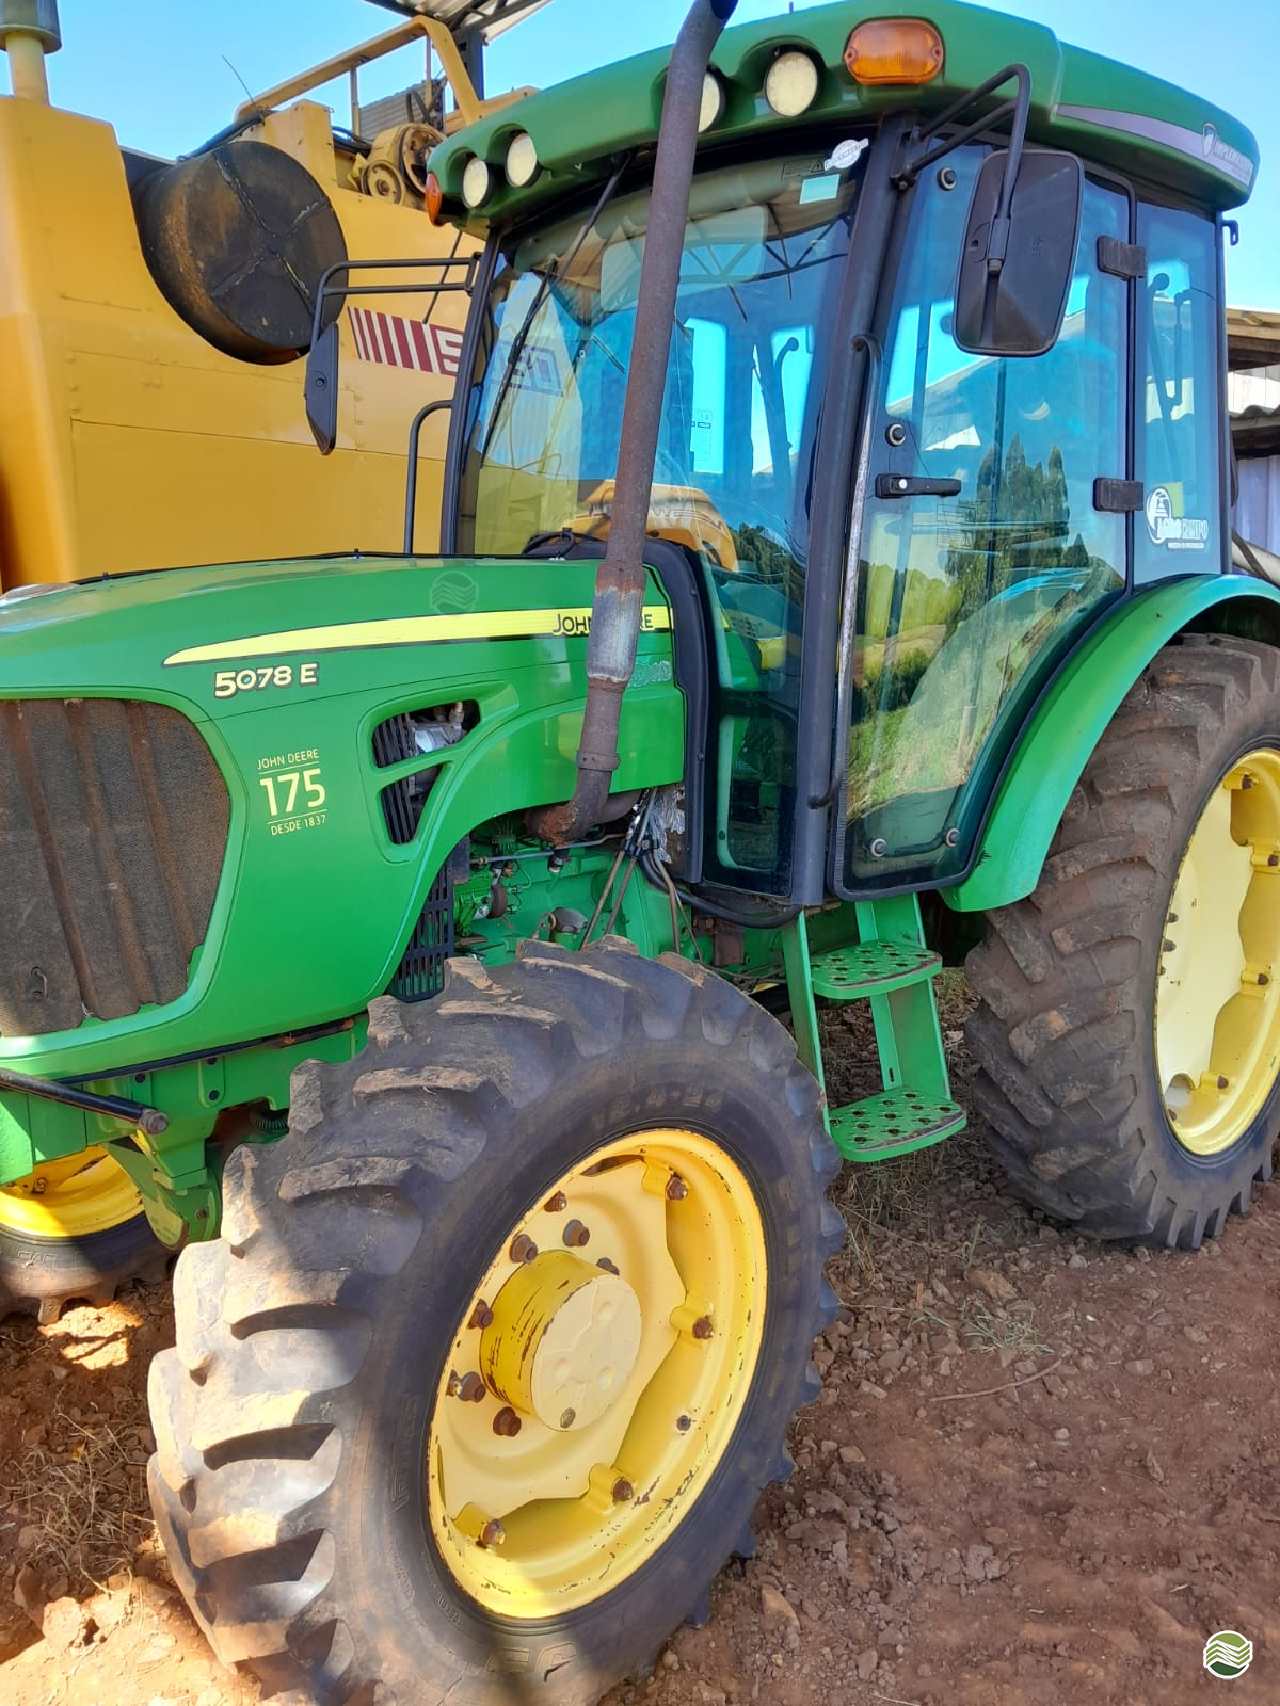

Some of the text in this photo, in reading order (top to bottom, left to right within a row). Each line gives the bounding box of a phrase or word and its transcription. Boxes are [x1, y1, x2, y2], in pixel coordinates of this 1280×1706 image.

[553, 613, 592, 634] JOH
[214, 662, 318, 697] 5078 E
[258, 749, 320, 770] JOHN DEERE
[259, 768, 326, 817] 175
[270, 814, 326, 836] DESDE 1837
